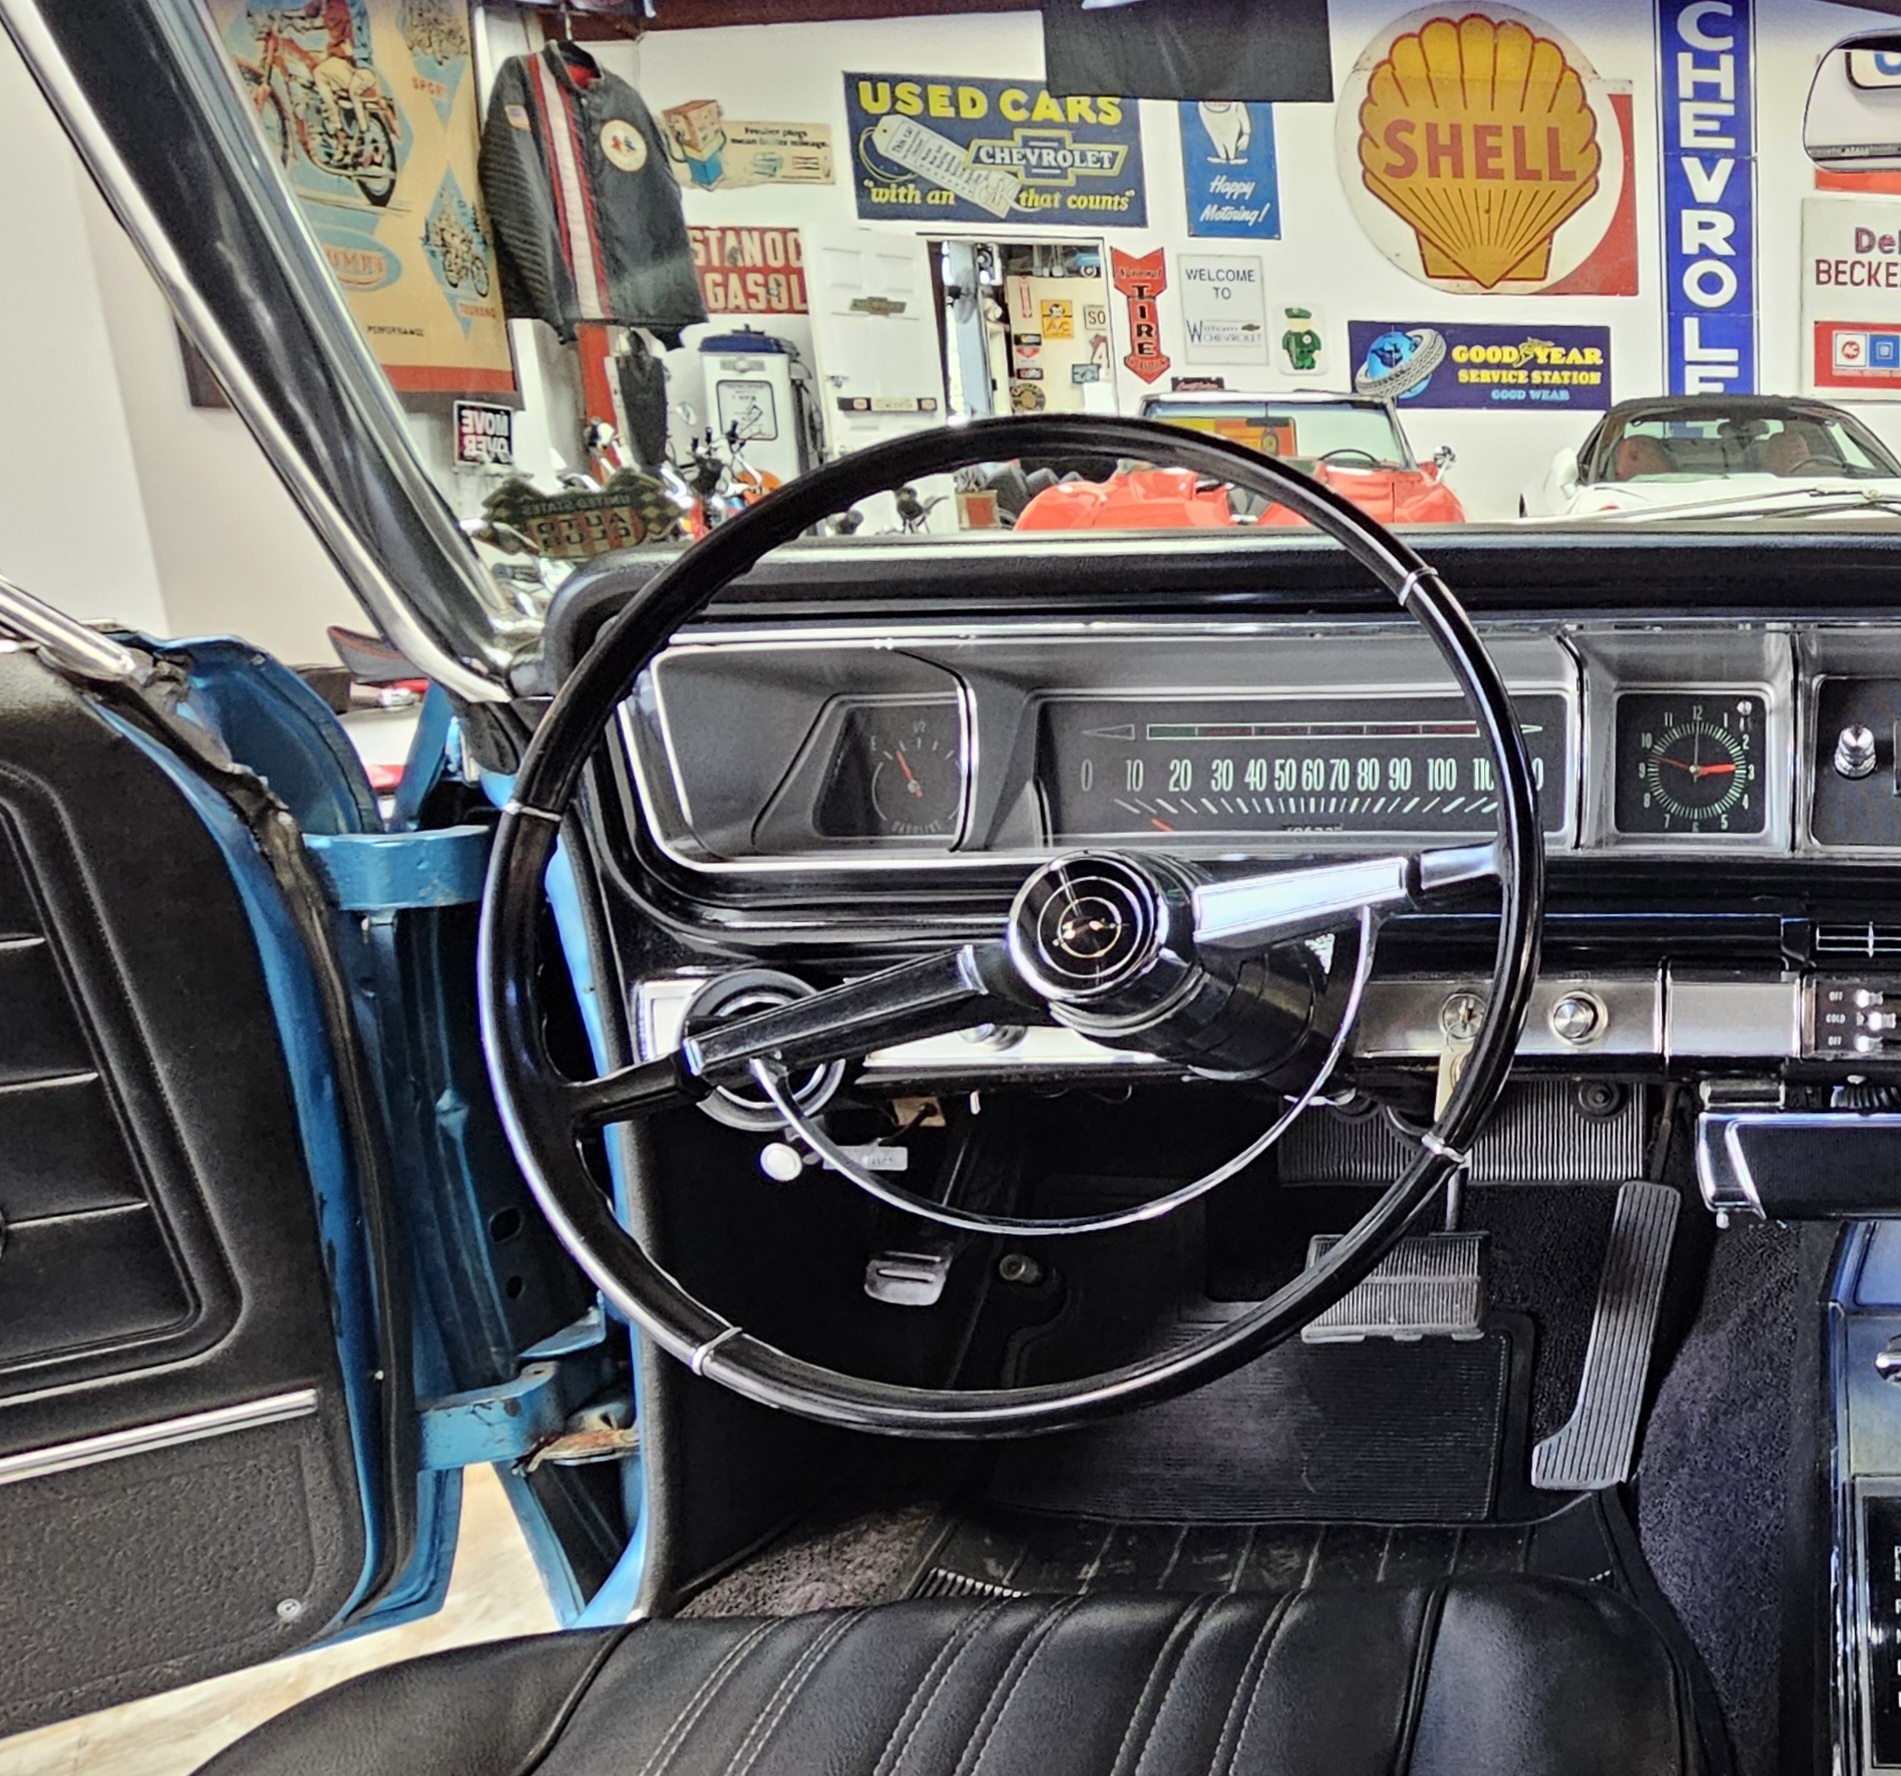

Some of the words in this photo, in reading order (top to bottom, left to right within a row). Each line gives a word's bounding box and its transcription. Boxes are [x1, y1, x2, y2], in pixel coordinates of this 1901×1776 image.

[858, 81, 989, 119] USED
[998, 88, 1122, 126] CARS
[979, 146, 1113, 169] CHEVROLET
[1383, 119, 1577, 181] SHELL
[1209, 175, 1255, 200] Happy
[926, 190, 955, 205] an
[1019, 189, 1062, 209] that
[1199, 202, 1271, 227] Motoring!
[1185, 268, 1256, 283] WELCOME
[1213, 287, 1231, 300] TO
[1131, 285, 1155, 355] TIRE
[1458, 369, 1529, 384] SERVICE
[1531, 370, 1602, 385] STATION
[1491, 389, 1526, 401] GOOD
[1664, 712, 1673, 727] 11
[1693, 705, 1703, 720] 12
[1641, 733, 1652, 749] 10
[1742, 734, 1750, 750] 2
[1081, 758, 1093, 792] 0
[1126, 758, 1144, 792] 10
[1168, 758, 1192, 792] 20
[1211, 758, 1234, 792] 30
[1244, 758, 1267, 792] 40
[1274, 758, 1297, 792] 50
[1302, 757, 1325, 792] 60
[1329, 758, 1350, 791] 70
[1357, 757, 1380, 792] 80
[1388, 757, 1412, 791] 90
[1427, 757, 1457, 791] 100
[1638, 762, 1646, 779] 9
[1747, 764, 1755, 780] 3
[1643, 792, 1651, 809] 8
[1742, 793, 1749, 810] 4
[1664, 814, 1671, 829] 7
[1720, 814, 1728, 830] 5
[1692, 821, 1699, 833] 6
[1825, 1013, 1846, 1024] COLD
